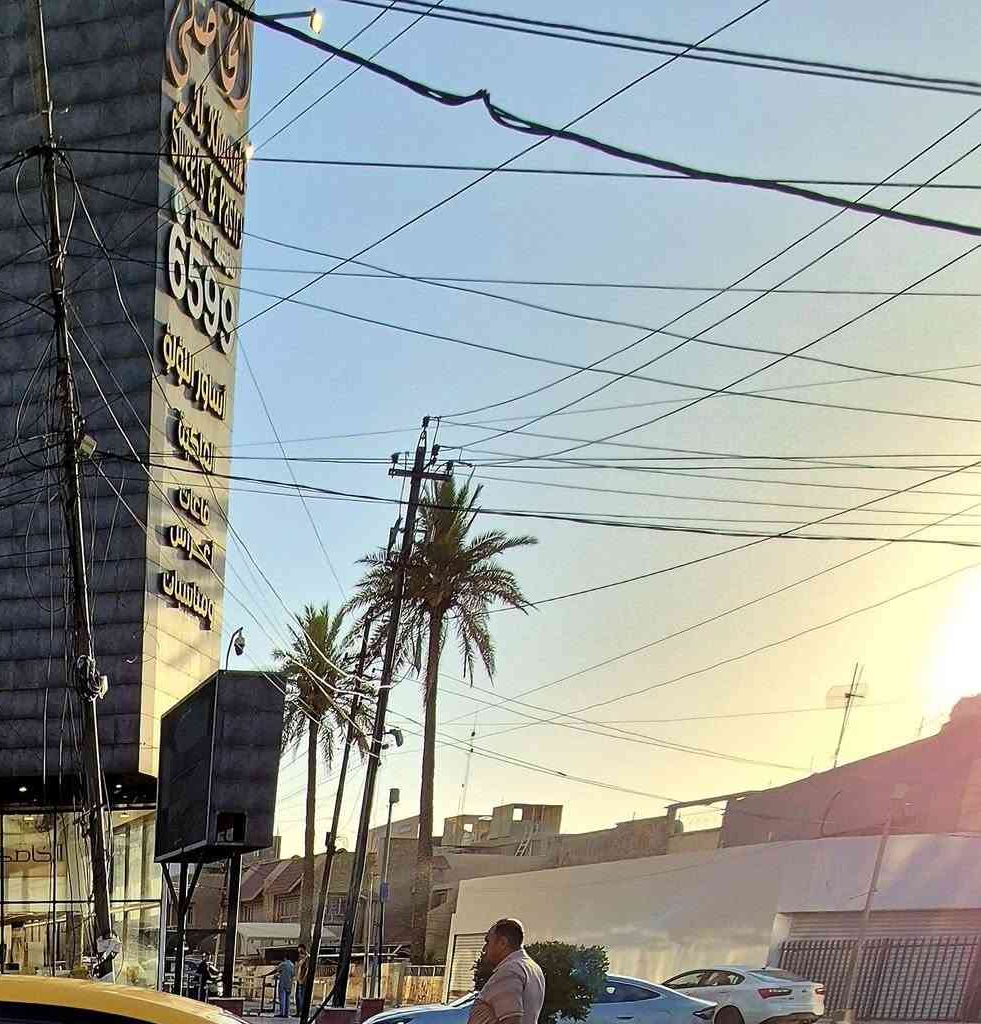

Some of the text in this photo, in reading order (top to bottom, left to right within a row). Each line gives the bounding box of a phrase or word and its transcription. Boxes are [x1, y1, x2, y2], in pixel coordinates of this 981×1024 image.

[171, 109, 205, 200] Sweets
[208, 163, 217, 217] &
[168, 223, 235, 354] 6599
[178, 488, 211, 526] قاعات
[163, 570, 216, 629] ومناسبات
